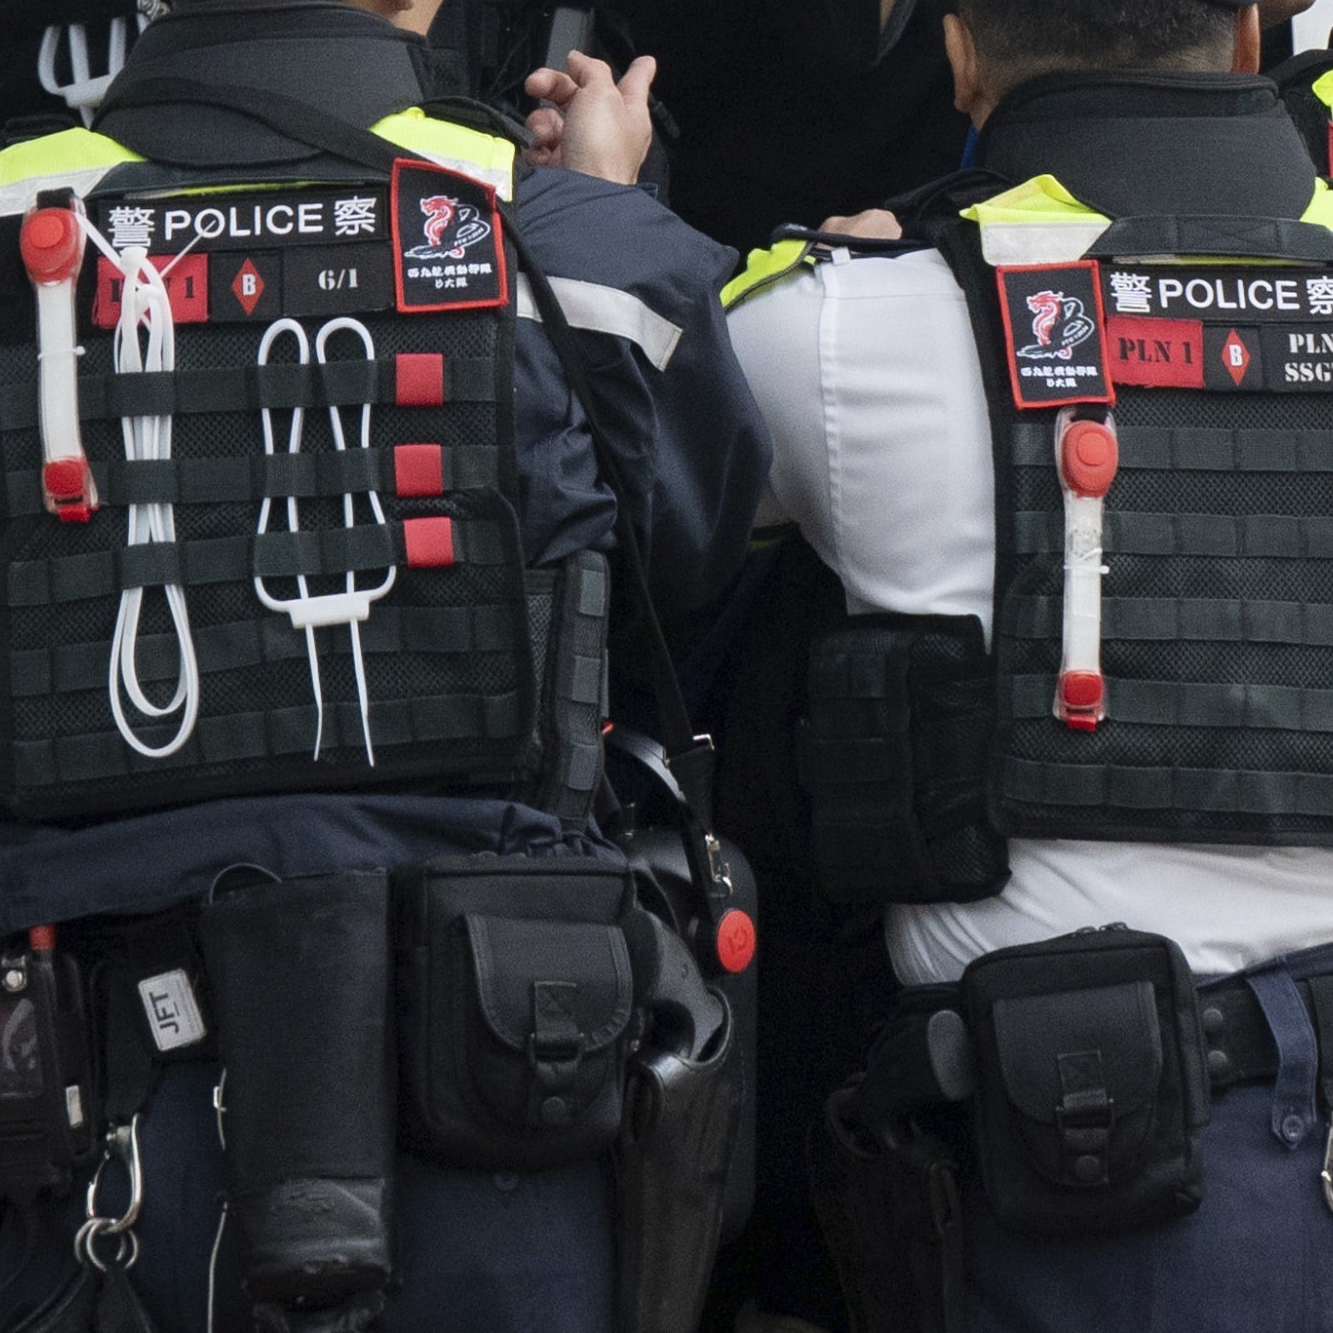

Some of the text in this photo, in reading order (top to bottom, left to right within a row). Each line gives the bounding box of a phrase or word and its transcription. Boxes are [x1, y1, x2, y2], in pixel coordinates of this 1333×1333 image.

[108, 195, 377, 247] 警 POLICE 察
[242, 273, 256, 296] B
[1110, 272, 1153, 314] 警
[1158, 278, 1301, 311] POLICE
[1118, 337, 1194, 364] PLN 1
[1229, 344, 1243, 367] B
